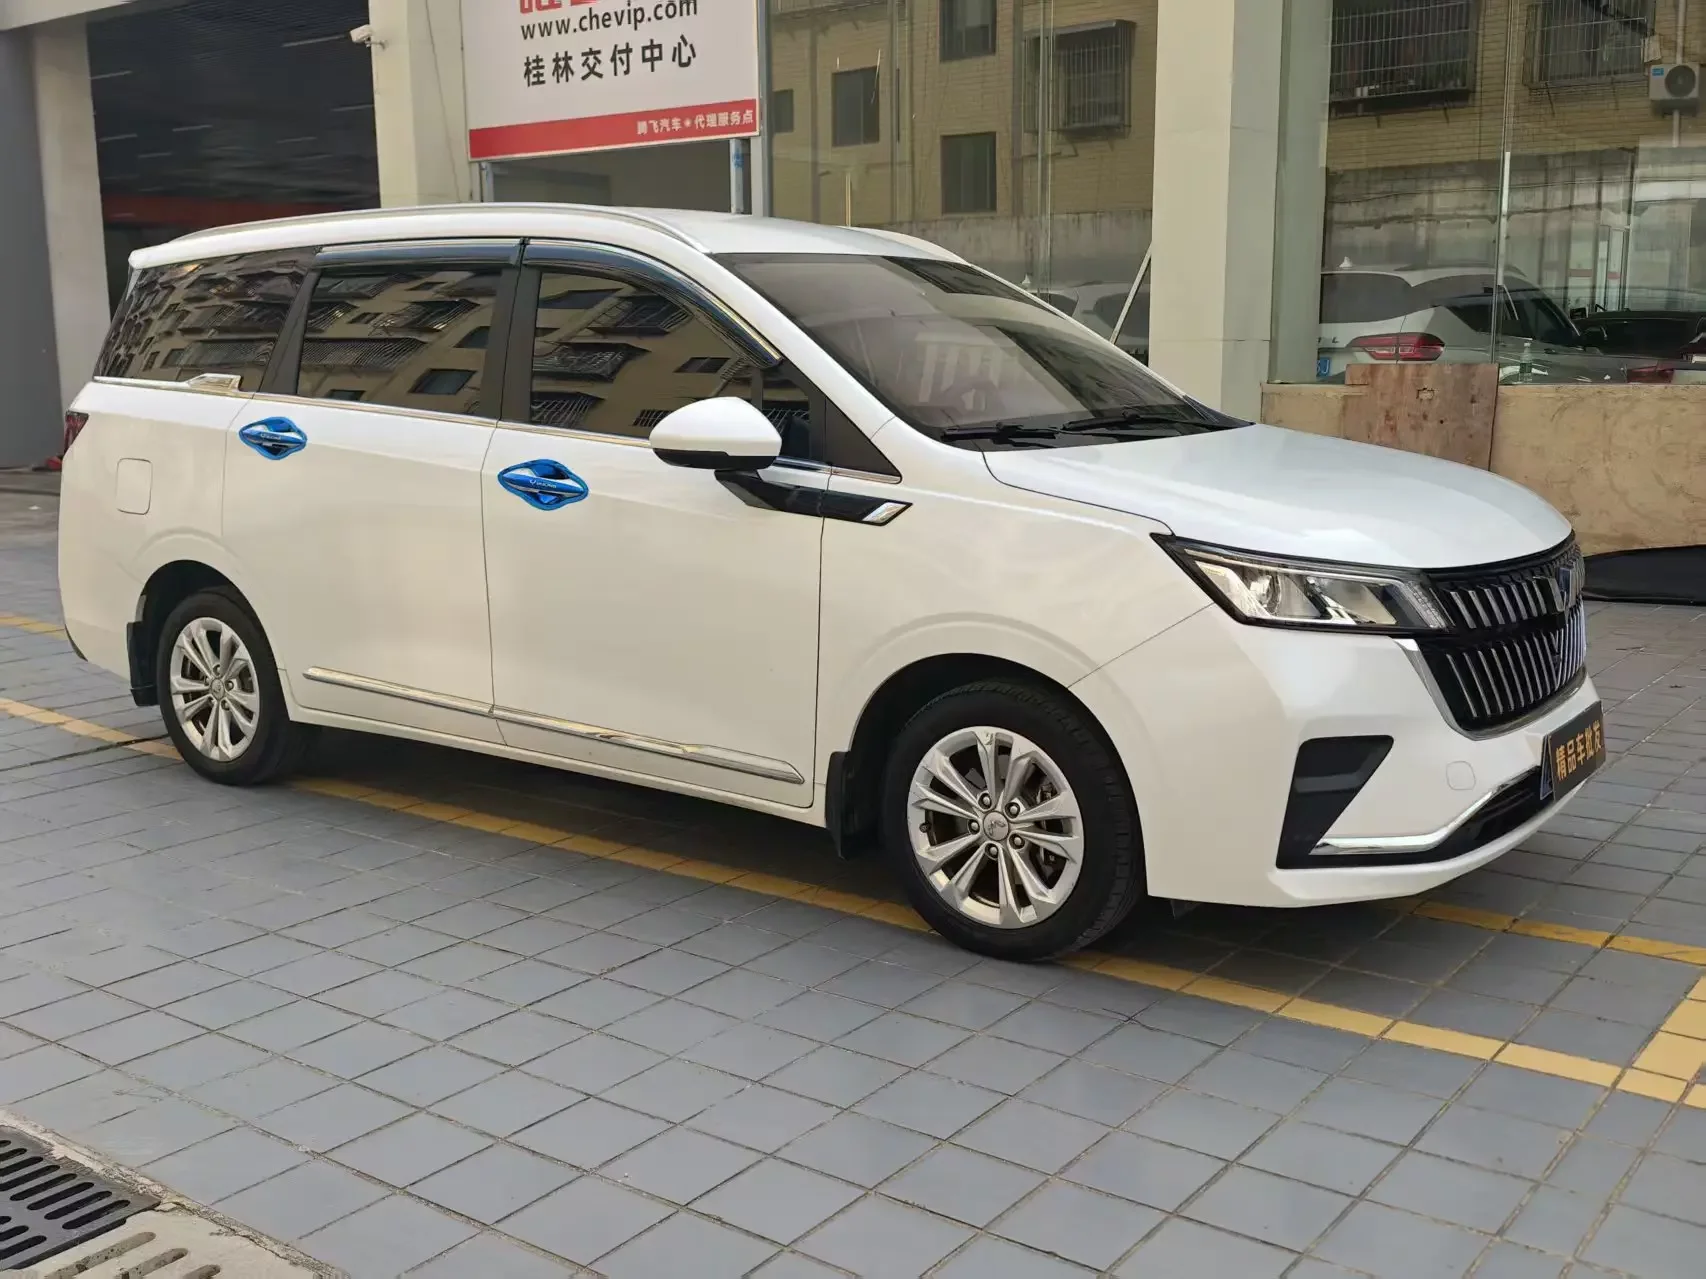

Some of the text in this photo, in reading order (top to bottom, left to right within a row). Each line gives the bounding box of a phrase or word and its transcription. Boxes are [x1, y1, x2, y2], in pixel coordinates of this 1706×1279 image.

[520, 0, 698, 40] www.chevip.com
[523, 34, 697, 87] 桂林交付中心
